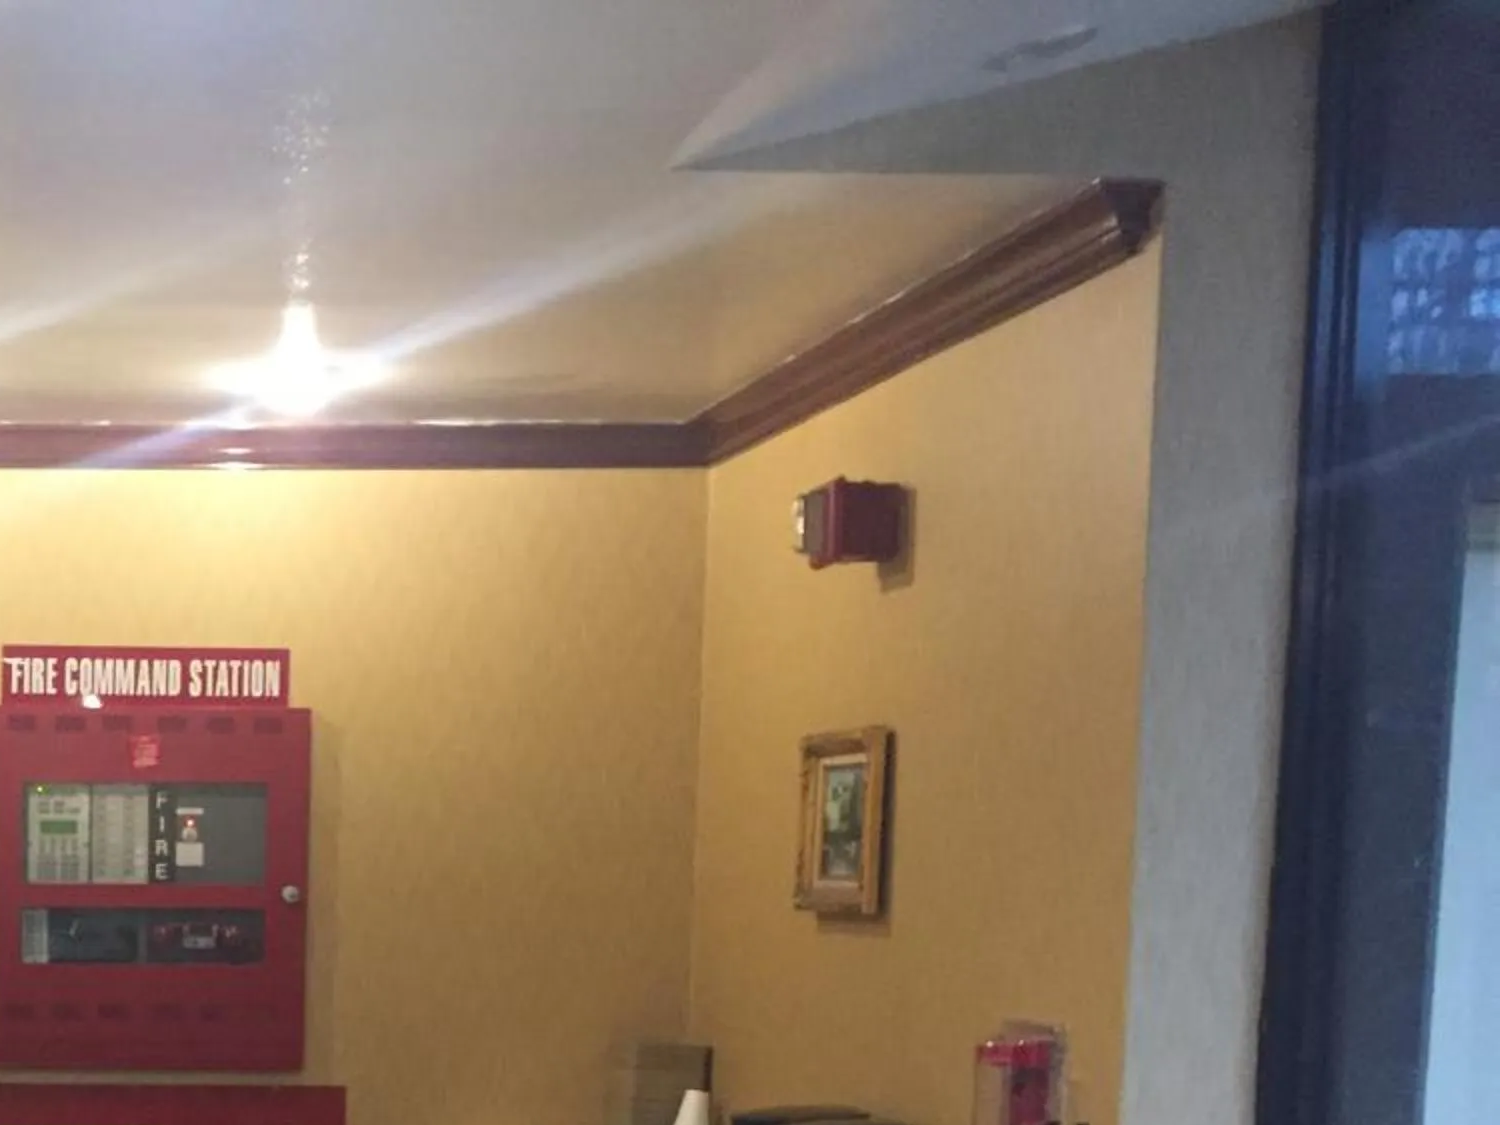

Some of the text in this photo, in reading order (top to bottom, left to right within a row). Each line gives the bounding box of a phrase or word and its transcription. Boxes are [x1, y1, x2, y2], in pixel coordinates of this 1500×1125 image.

[9, 657, 280, 697] FIRE COMMAND STATION
[155, 791, 168, 880] FIRE
